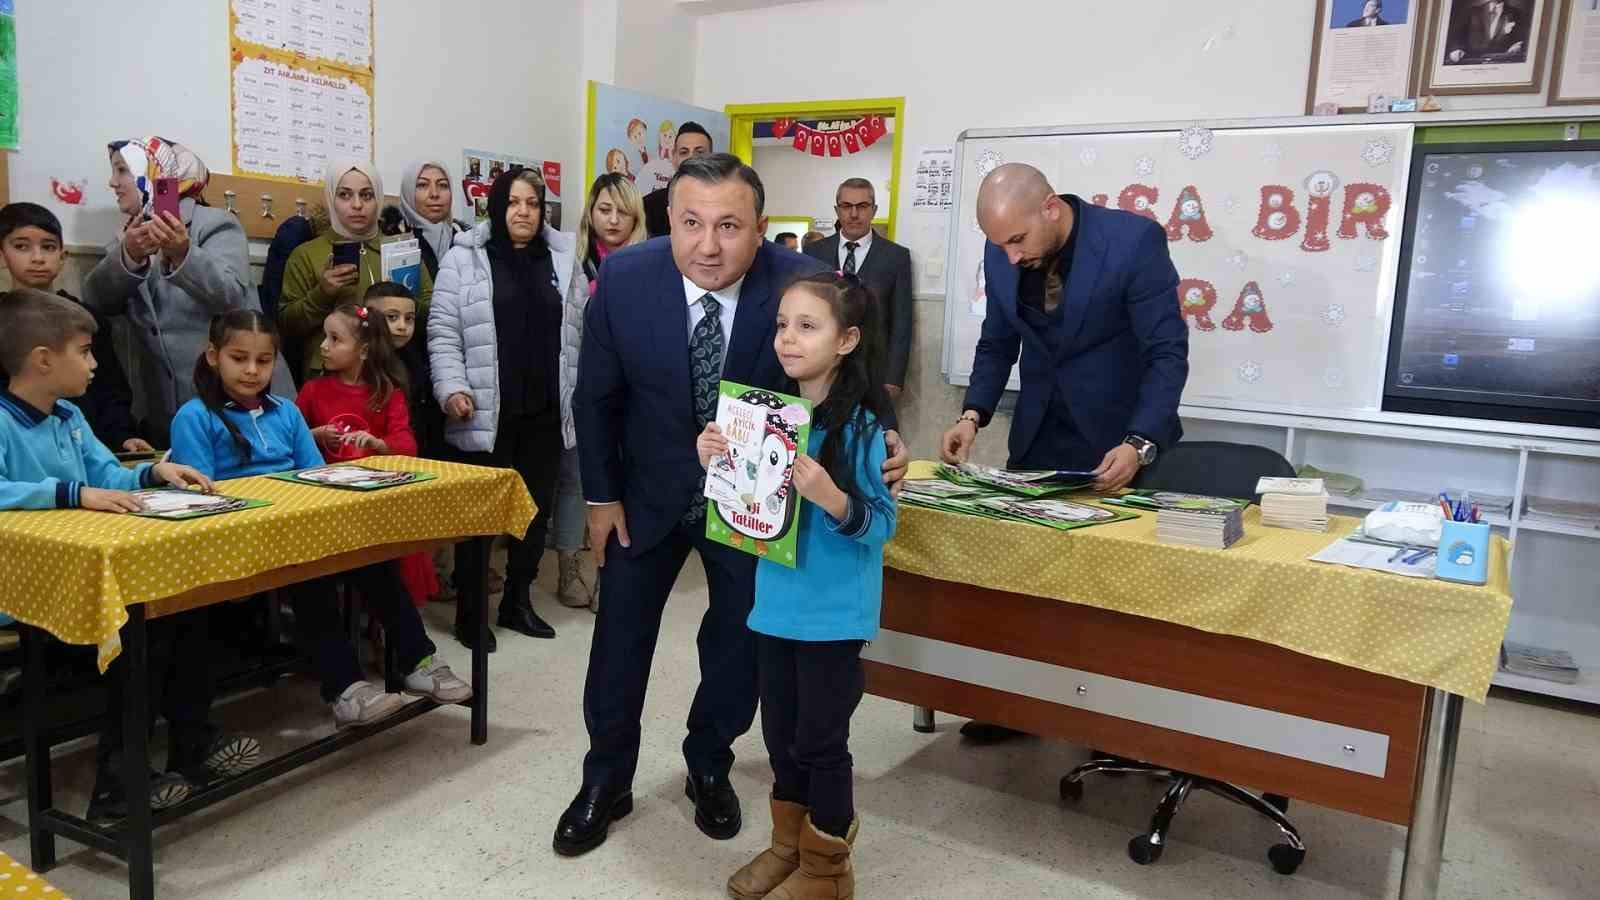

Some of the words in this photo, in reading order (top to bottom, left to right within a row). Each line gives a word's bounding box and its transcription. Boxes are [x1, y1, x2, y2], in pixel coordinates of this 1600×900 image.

[1093, 183, 1214, 242] SA
[1176, 277, 1274, 333] RA
[731, 510, 774, 534] Tatiller
